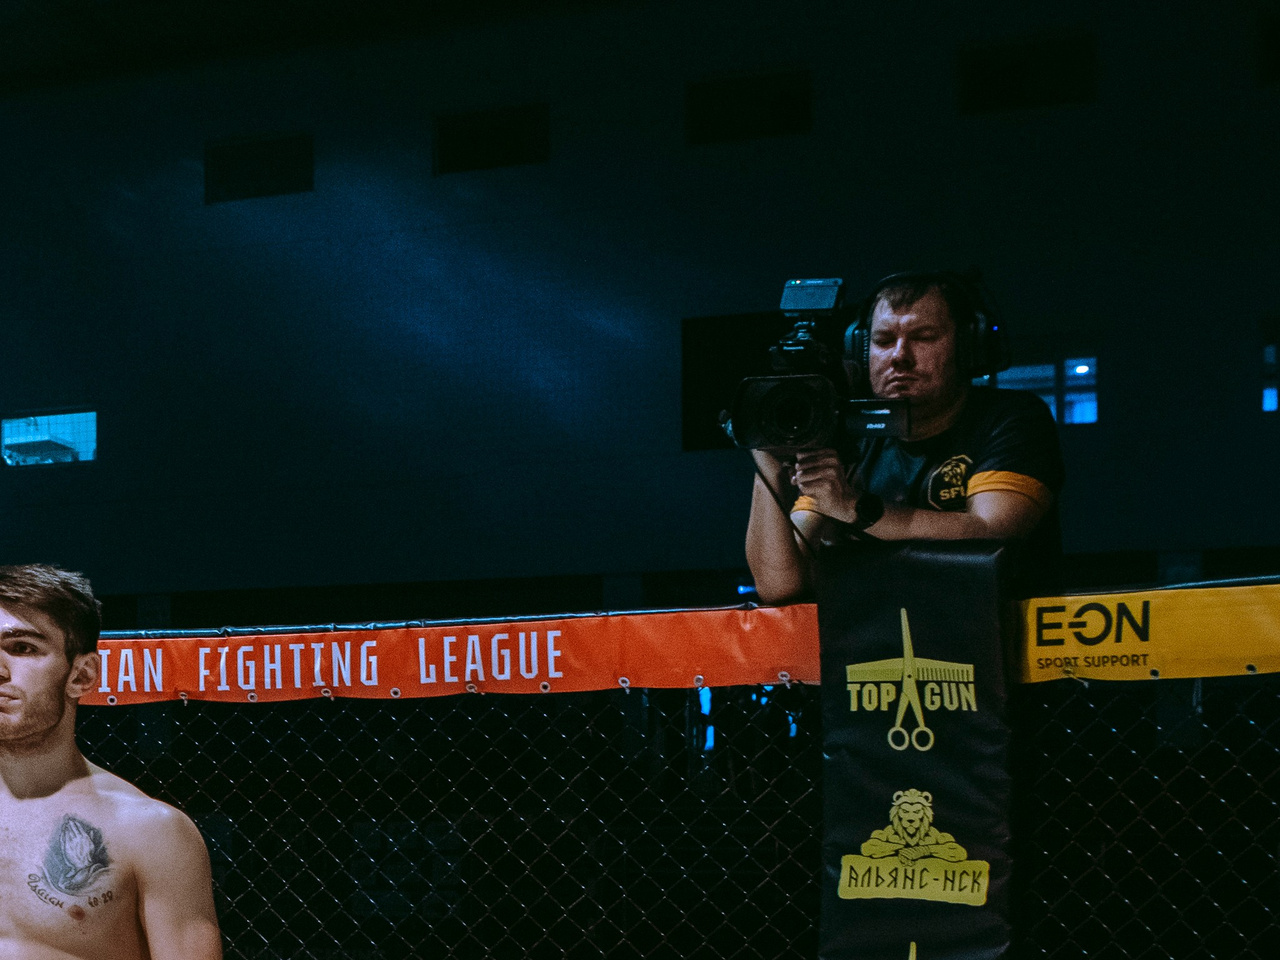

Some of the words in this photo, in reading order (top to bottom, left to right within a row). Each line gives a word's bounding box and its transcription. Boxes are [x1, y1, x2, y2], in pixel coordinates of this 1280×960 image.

[199, 640, 378, 692] FIGHTING
[418, 630, 563, 684] LEAGUE
[1037, 657, 1079, 669] SPORT
[1084, 654, 1149, 668] SUPPORT
[846, 683, 896, 712] TOP
[924, 682, 978, 712] GUN
[848, 864, 982, 893] АЛЬЯНС-НСК
